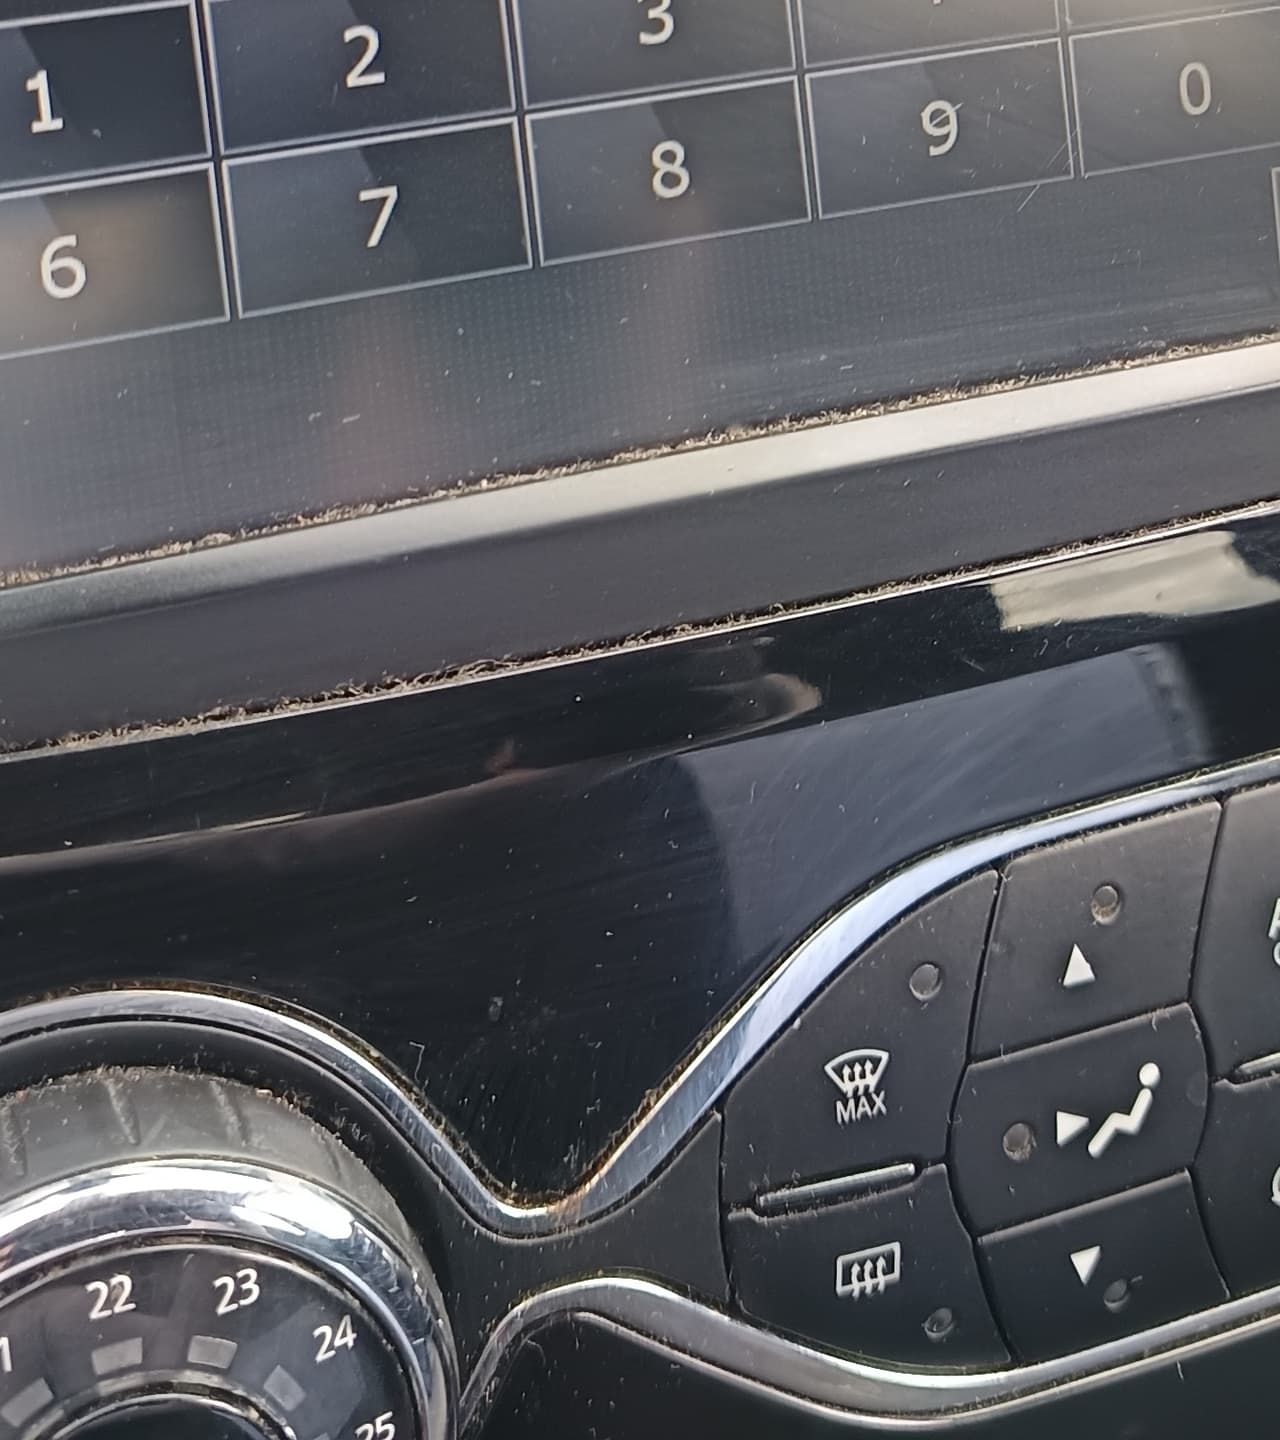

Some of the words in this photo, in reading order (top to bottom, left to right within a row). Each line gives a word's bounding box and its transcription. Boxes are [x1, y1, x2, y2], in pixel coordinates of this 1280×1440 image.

[343, 25, 386, 88] 2
[26, 70, 64, 133] 1
[1178, 62, 1212, 117] 0
[921, 100, 959, 157] 9
[651, 140, 690, 198] 8
[360, 186, 398, 248] 7
[40, 235, 86, 298] 6
[835, 1090, 888, 1124] MAX
[86, 1276, 137, 1321] 22
[214, 1268, 261, 1316] 23
[313, 1314, 357, 1364] 24
